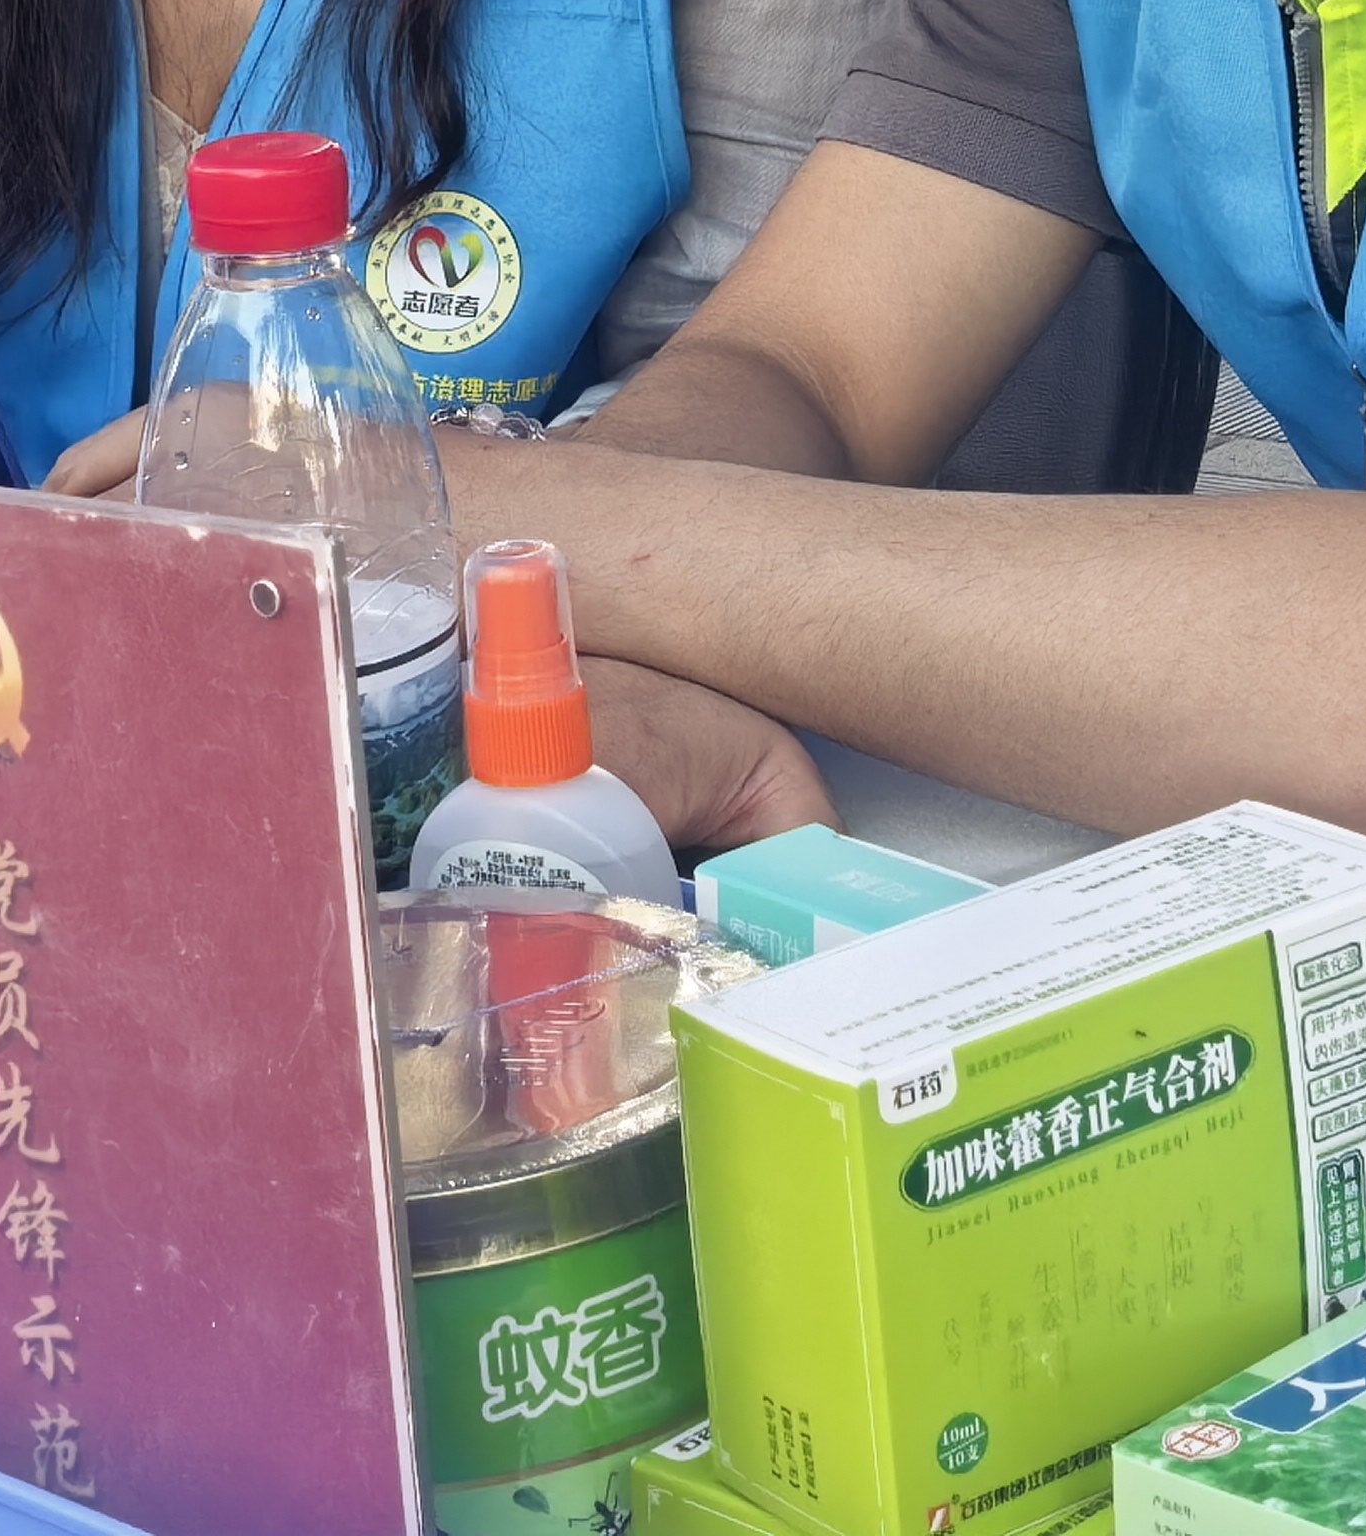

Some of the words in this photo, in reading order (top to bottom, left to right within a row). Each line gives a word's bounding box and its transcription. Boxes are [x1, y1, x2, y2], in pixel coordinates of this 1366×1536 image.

[401, 290, 481, 318] 志愿者
[890, 1073, 944, 1110] 石药
[924, 1034, 1239, 1207] 加味藿香正气合剂
[926, 1206, 992, 1246] Jiawei
[1007, 1168, 1100, 1212] Huoxiang
[1114, 1131, 1192, 1174] Zhengqi
[1206, 1107, 1247, 1137] Heji
[479, 1273, 667, 1423] 蚊香
[941, 1416, 981, 1447] 10ml
[947, 1442, 981, 1470] 10支
